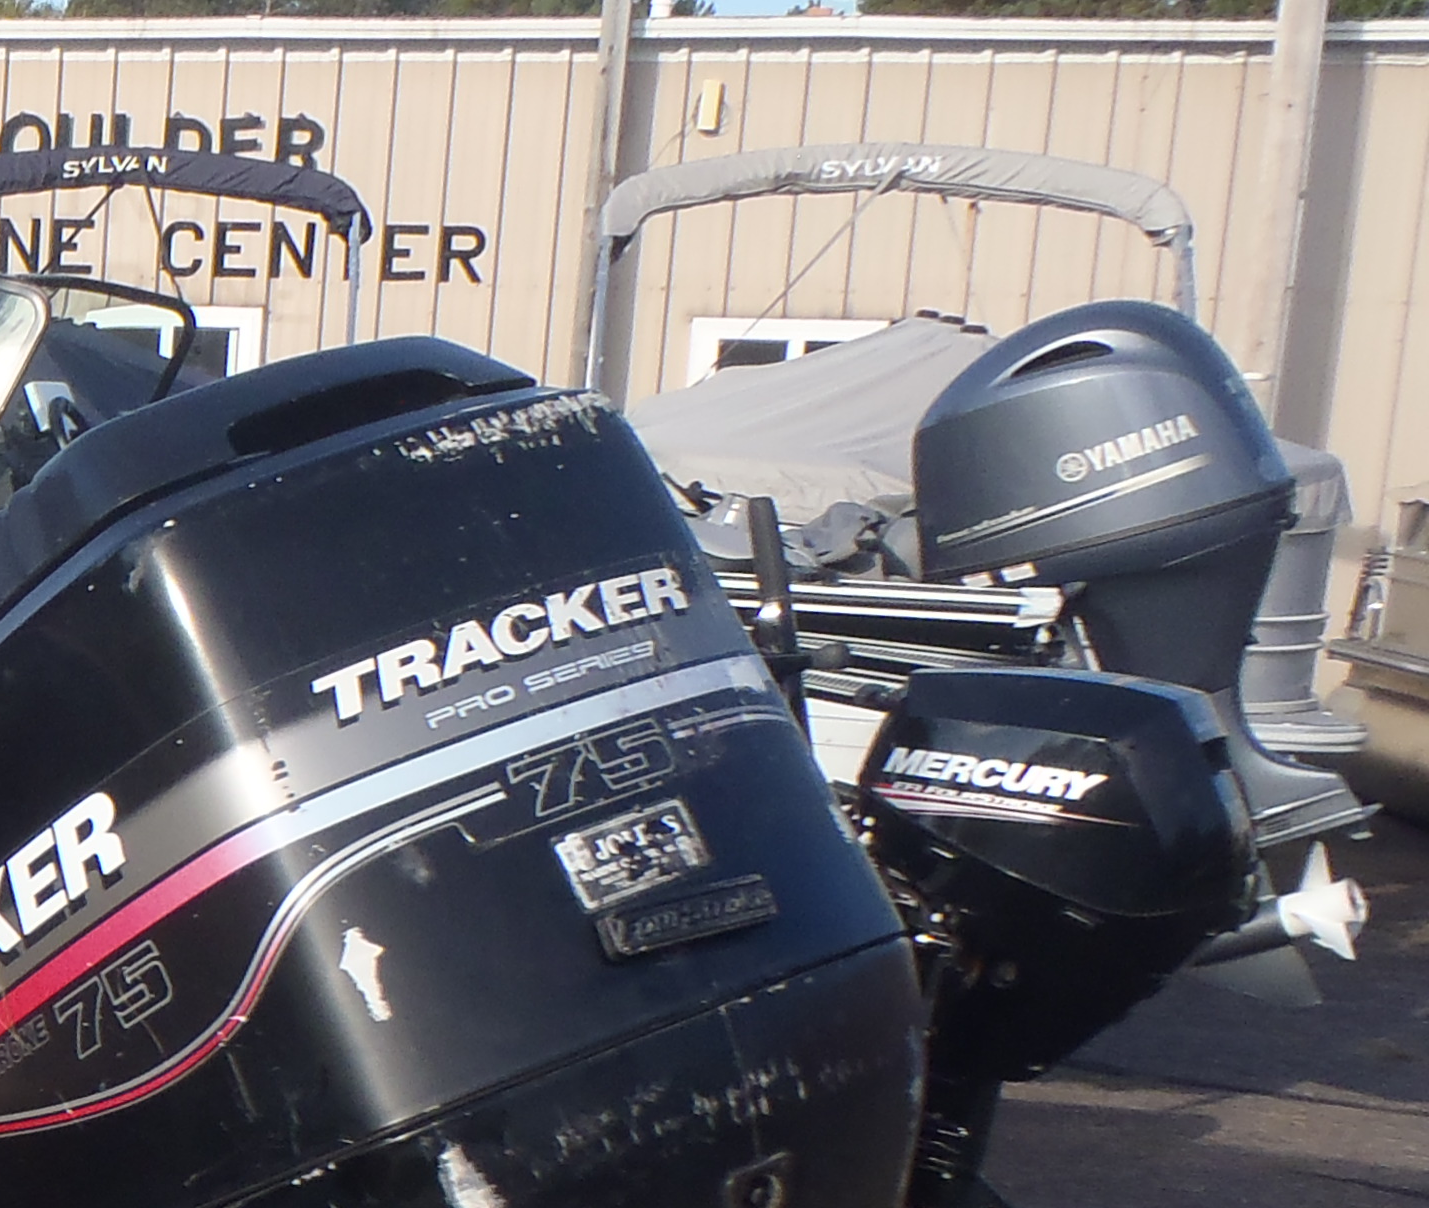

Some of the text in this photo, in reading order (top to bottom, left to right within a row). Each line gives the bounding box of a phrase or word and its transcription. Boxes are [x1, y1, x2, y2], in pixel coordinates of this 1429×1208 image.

[62, 155, 168, 179] SYLVAN
[1084, 415, 1200, 471] YAMAHA
[312, 567, 691, 724] TRACKER
[425, 640, 655, 728] PRO SERIES
[506, 717, 676, 818] 75
[882, 747, 1108, 800] MERCURY
[53, 939, 173, 1060] 75
